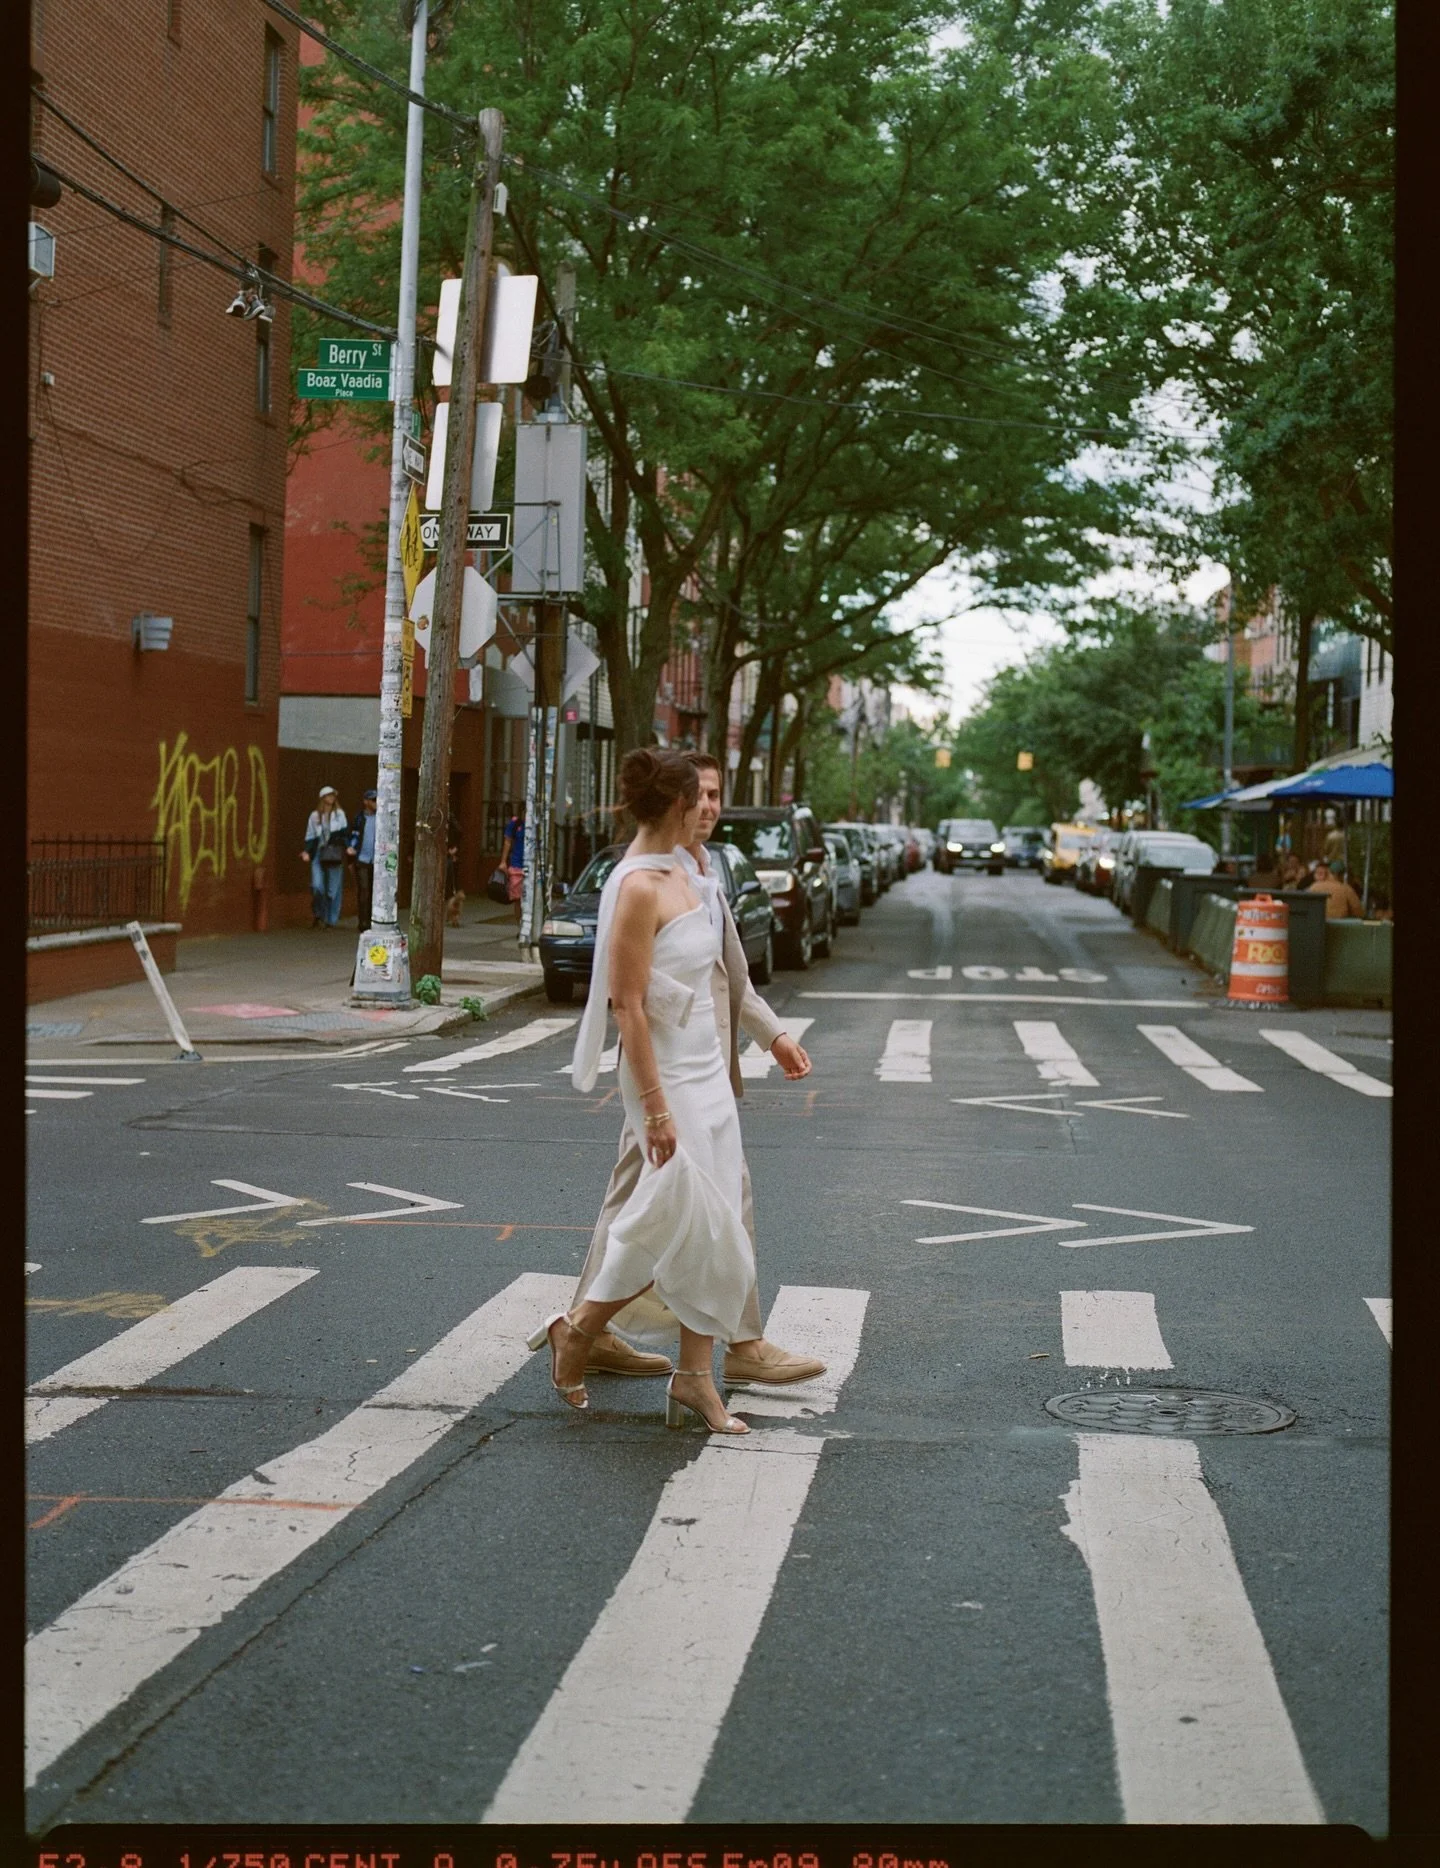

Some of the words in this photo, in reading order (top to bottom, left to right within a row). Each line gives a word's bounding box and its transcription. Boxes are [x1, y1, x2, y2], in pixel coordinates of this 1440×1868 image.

[328, 344, 367, 369] Berry
[371, 343, 382, 356] St
[306, 372, 337, 388] Boaz
[340, 373, 383, 389] Vaadia
[334, 388, 354, 398] Place
[423, 526, 440, 539] ON
[907, 965, 1109, 984] STOP
